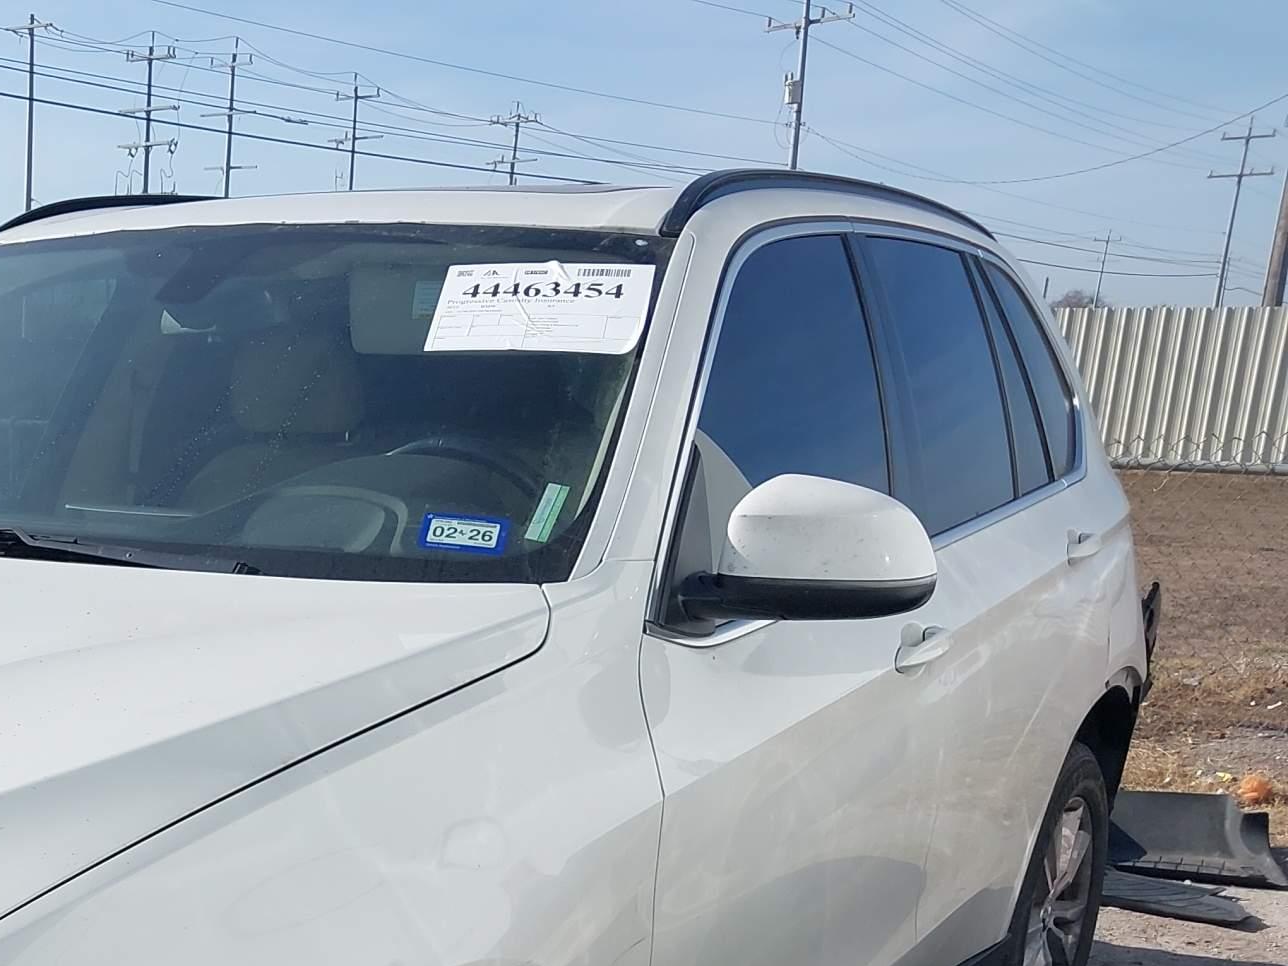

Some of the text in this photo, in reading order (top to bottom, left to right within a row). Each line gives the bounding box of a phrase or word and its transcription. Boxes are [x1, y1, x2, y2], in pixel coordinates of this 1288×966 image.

[462, 281, 624, 299] 44463454
[432, 525, 494, 542] 02 26
